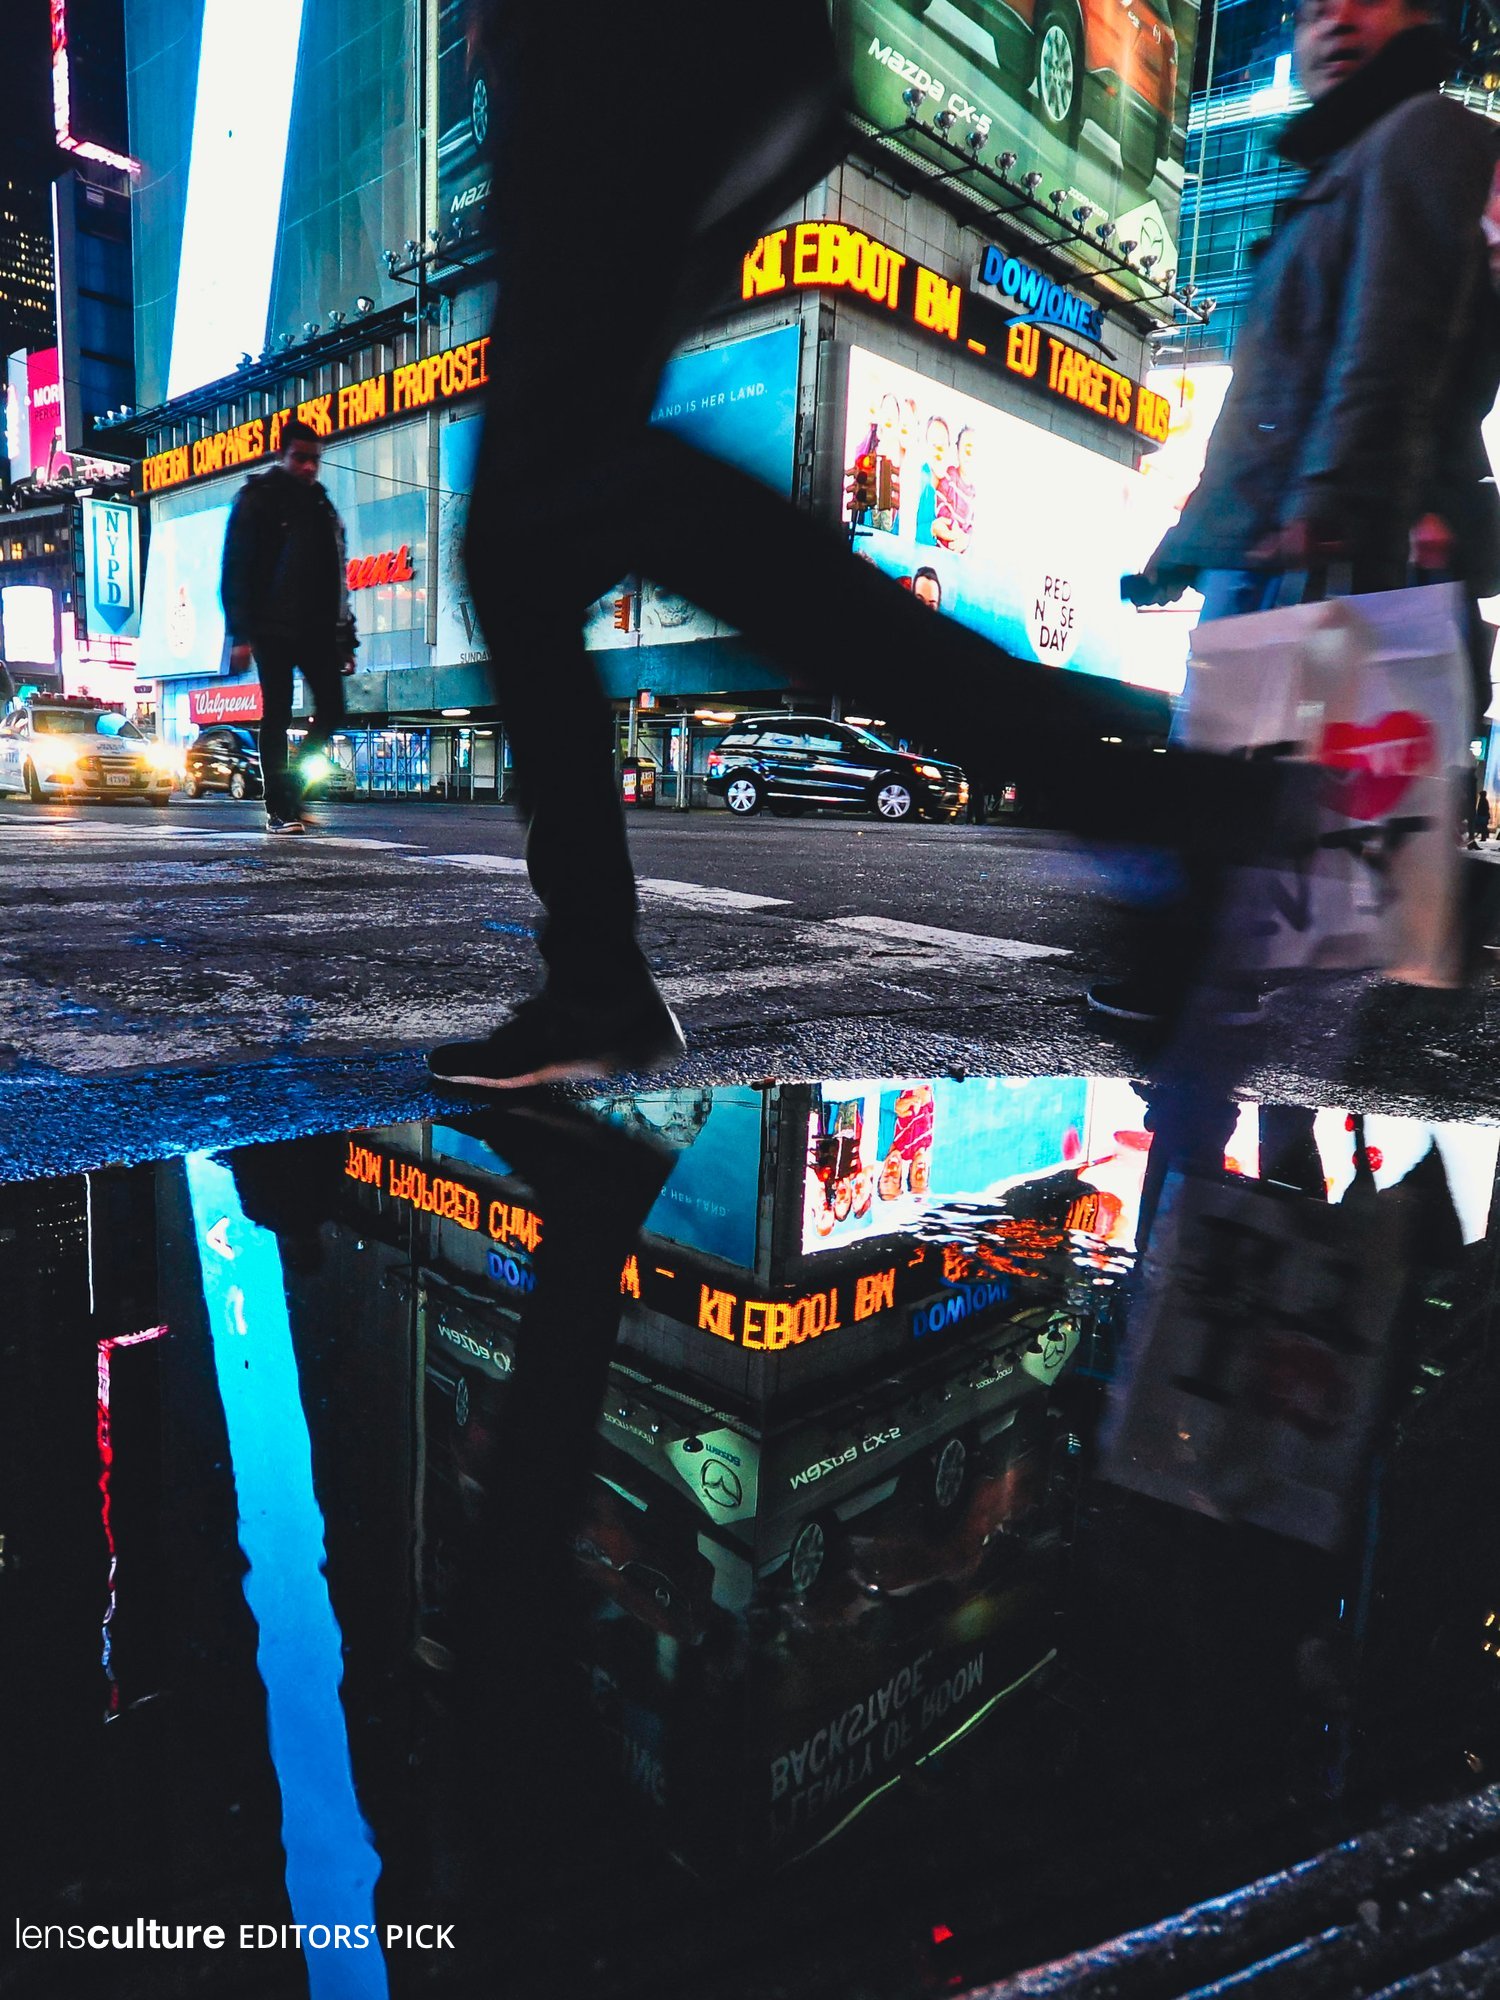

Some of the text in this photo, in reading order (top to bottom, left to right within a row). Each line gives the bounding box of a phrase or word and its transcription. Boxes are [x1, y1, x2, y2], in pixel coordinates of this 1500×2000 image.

[947, 93, 992, 134] CX-5
[1006, 322, 1040, 378] EU
[1048, 337, 1133, 425] TARGETS
[686, 400, 697, 413] IS
[701, 393, 725, 408] HER
[730, 383, 768, 402] LAND.
[142, 445, 189, 493] FOREIGN
[193, 418, 264, 476] COMPANIES
[270, 408, 291, 453] AT
[338, 374, 386, 430] FROM
[105, 511, 122, 605] NYPD
[1044, 575, 1072, 602] RED
[1039, 625, 1068, 652] DAY
[195, 690, 257, 721] Walgreens
